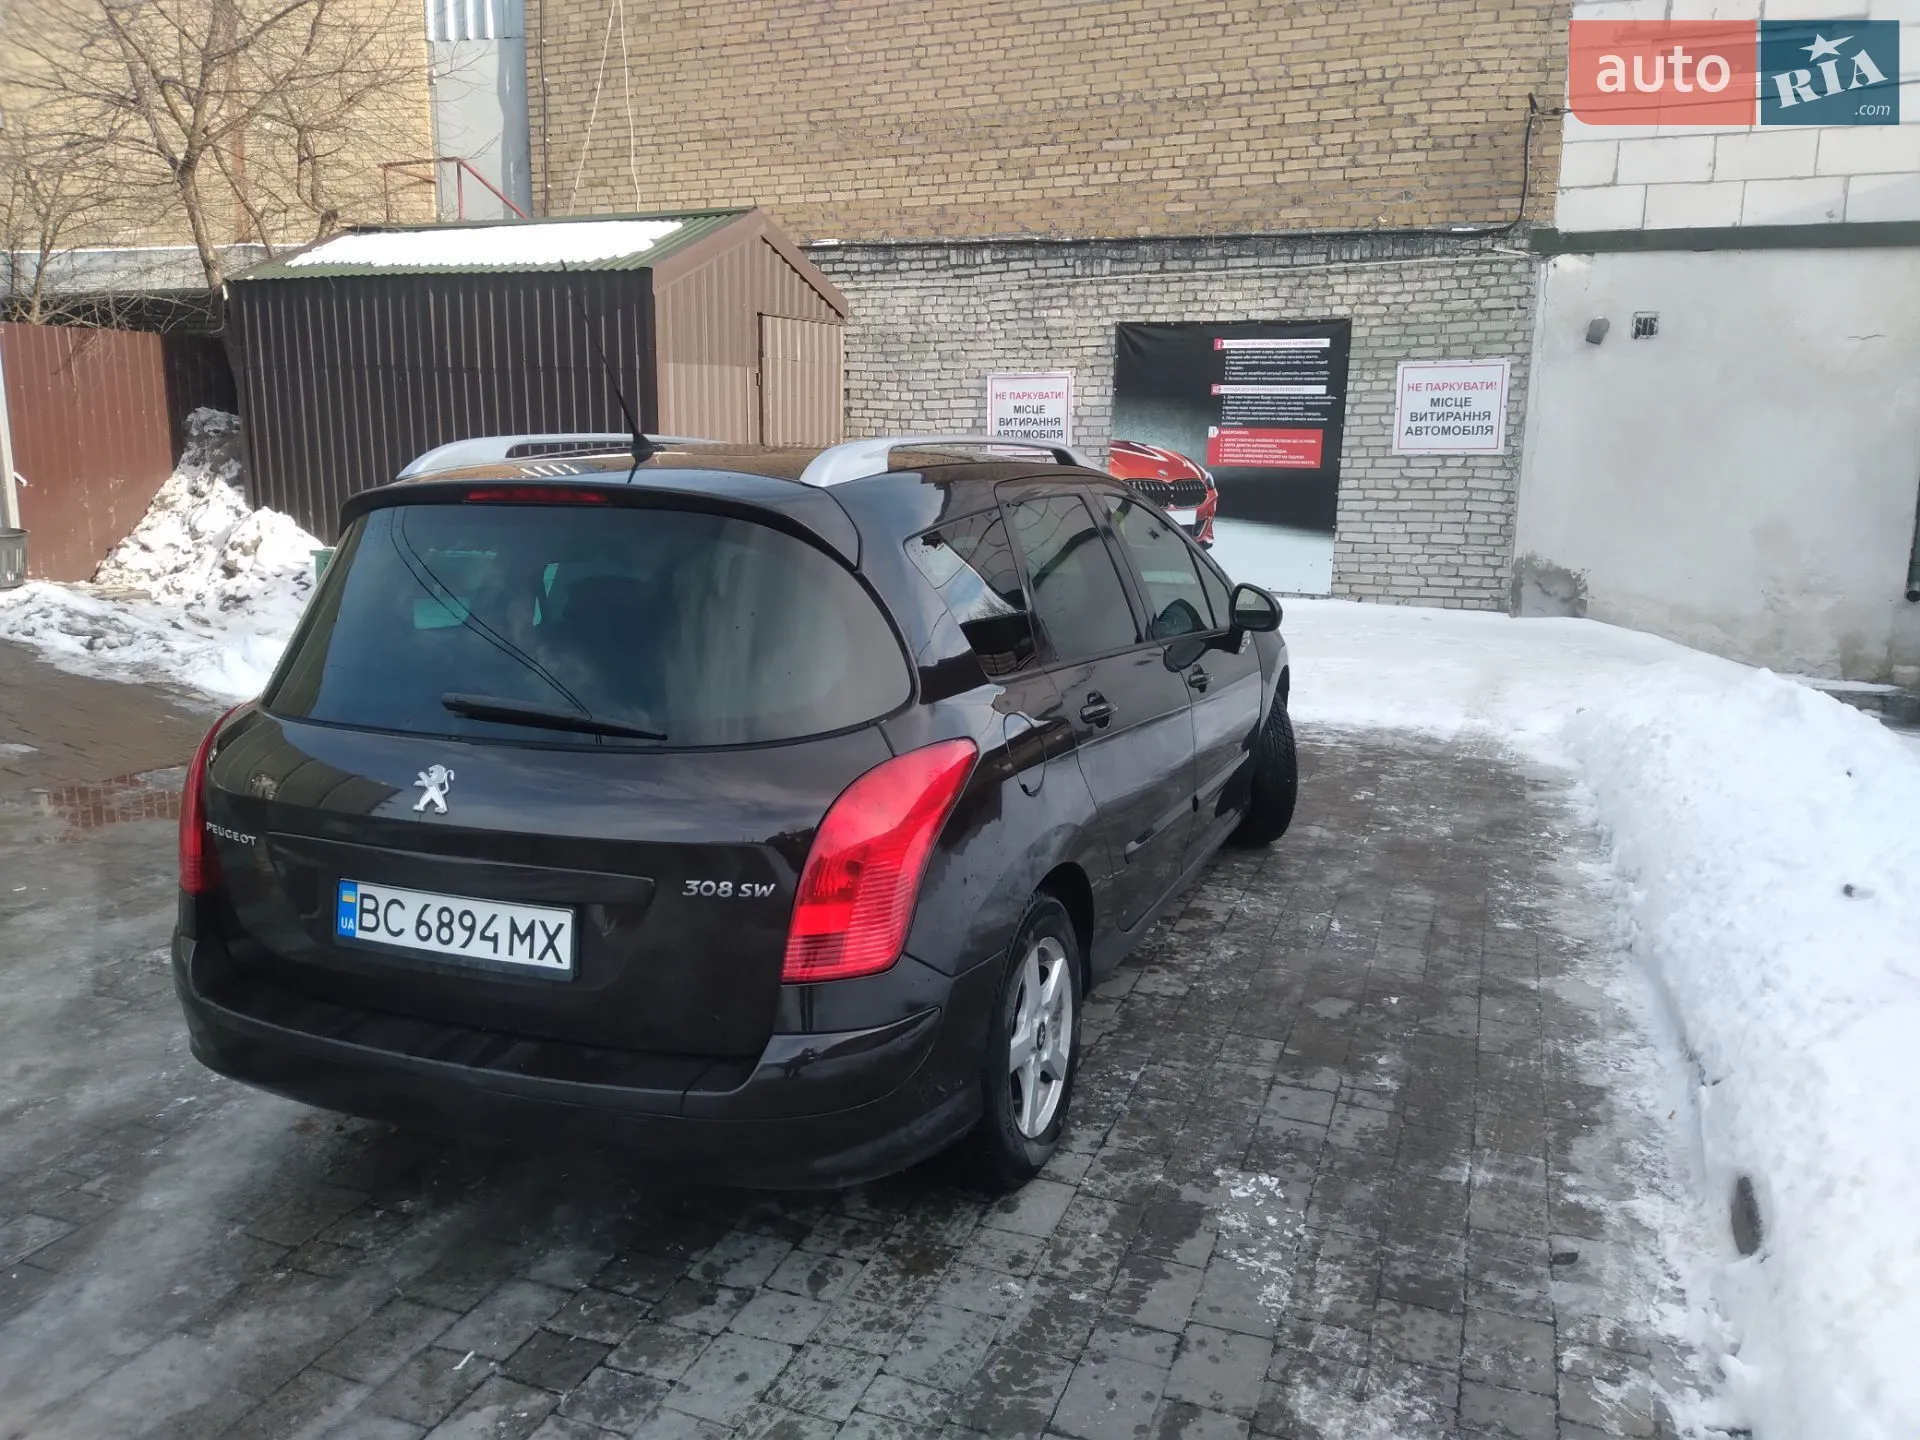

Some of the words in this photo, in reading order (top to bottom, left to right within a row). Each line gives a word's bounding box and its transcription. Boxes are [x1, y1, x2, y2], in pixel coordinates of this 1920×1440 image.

[1407, 382, 1422, 392] НЕ
[1425, 381, 1497, 392] ПАРКУВАТИ!
[995, 392, 1007, 400] НЕ
[1009, 391, 1064, 400] ПАРКУВАТИ!
[1430, 397, 1472, 408] МІСЦЕ
[1013, 404, 1046, 415] МІСЦЕ
[999, 417, 1061, 427] ВИТИРАННЯ
[1409, 411, 1491, 422] ВИТИРАННЯ
[996, 429, 1064, 439] АВТОМОБІЛЯ
[1404, 425, 1494, 436] АВТОМОБІЛЯ
[206, 821, 257, 847] PEUGEOT
[682, 880, 733, 898] 308
[738, 883, 776, 897] SW
[341, 917, 355, 931] UA
